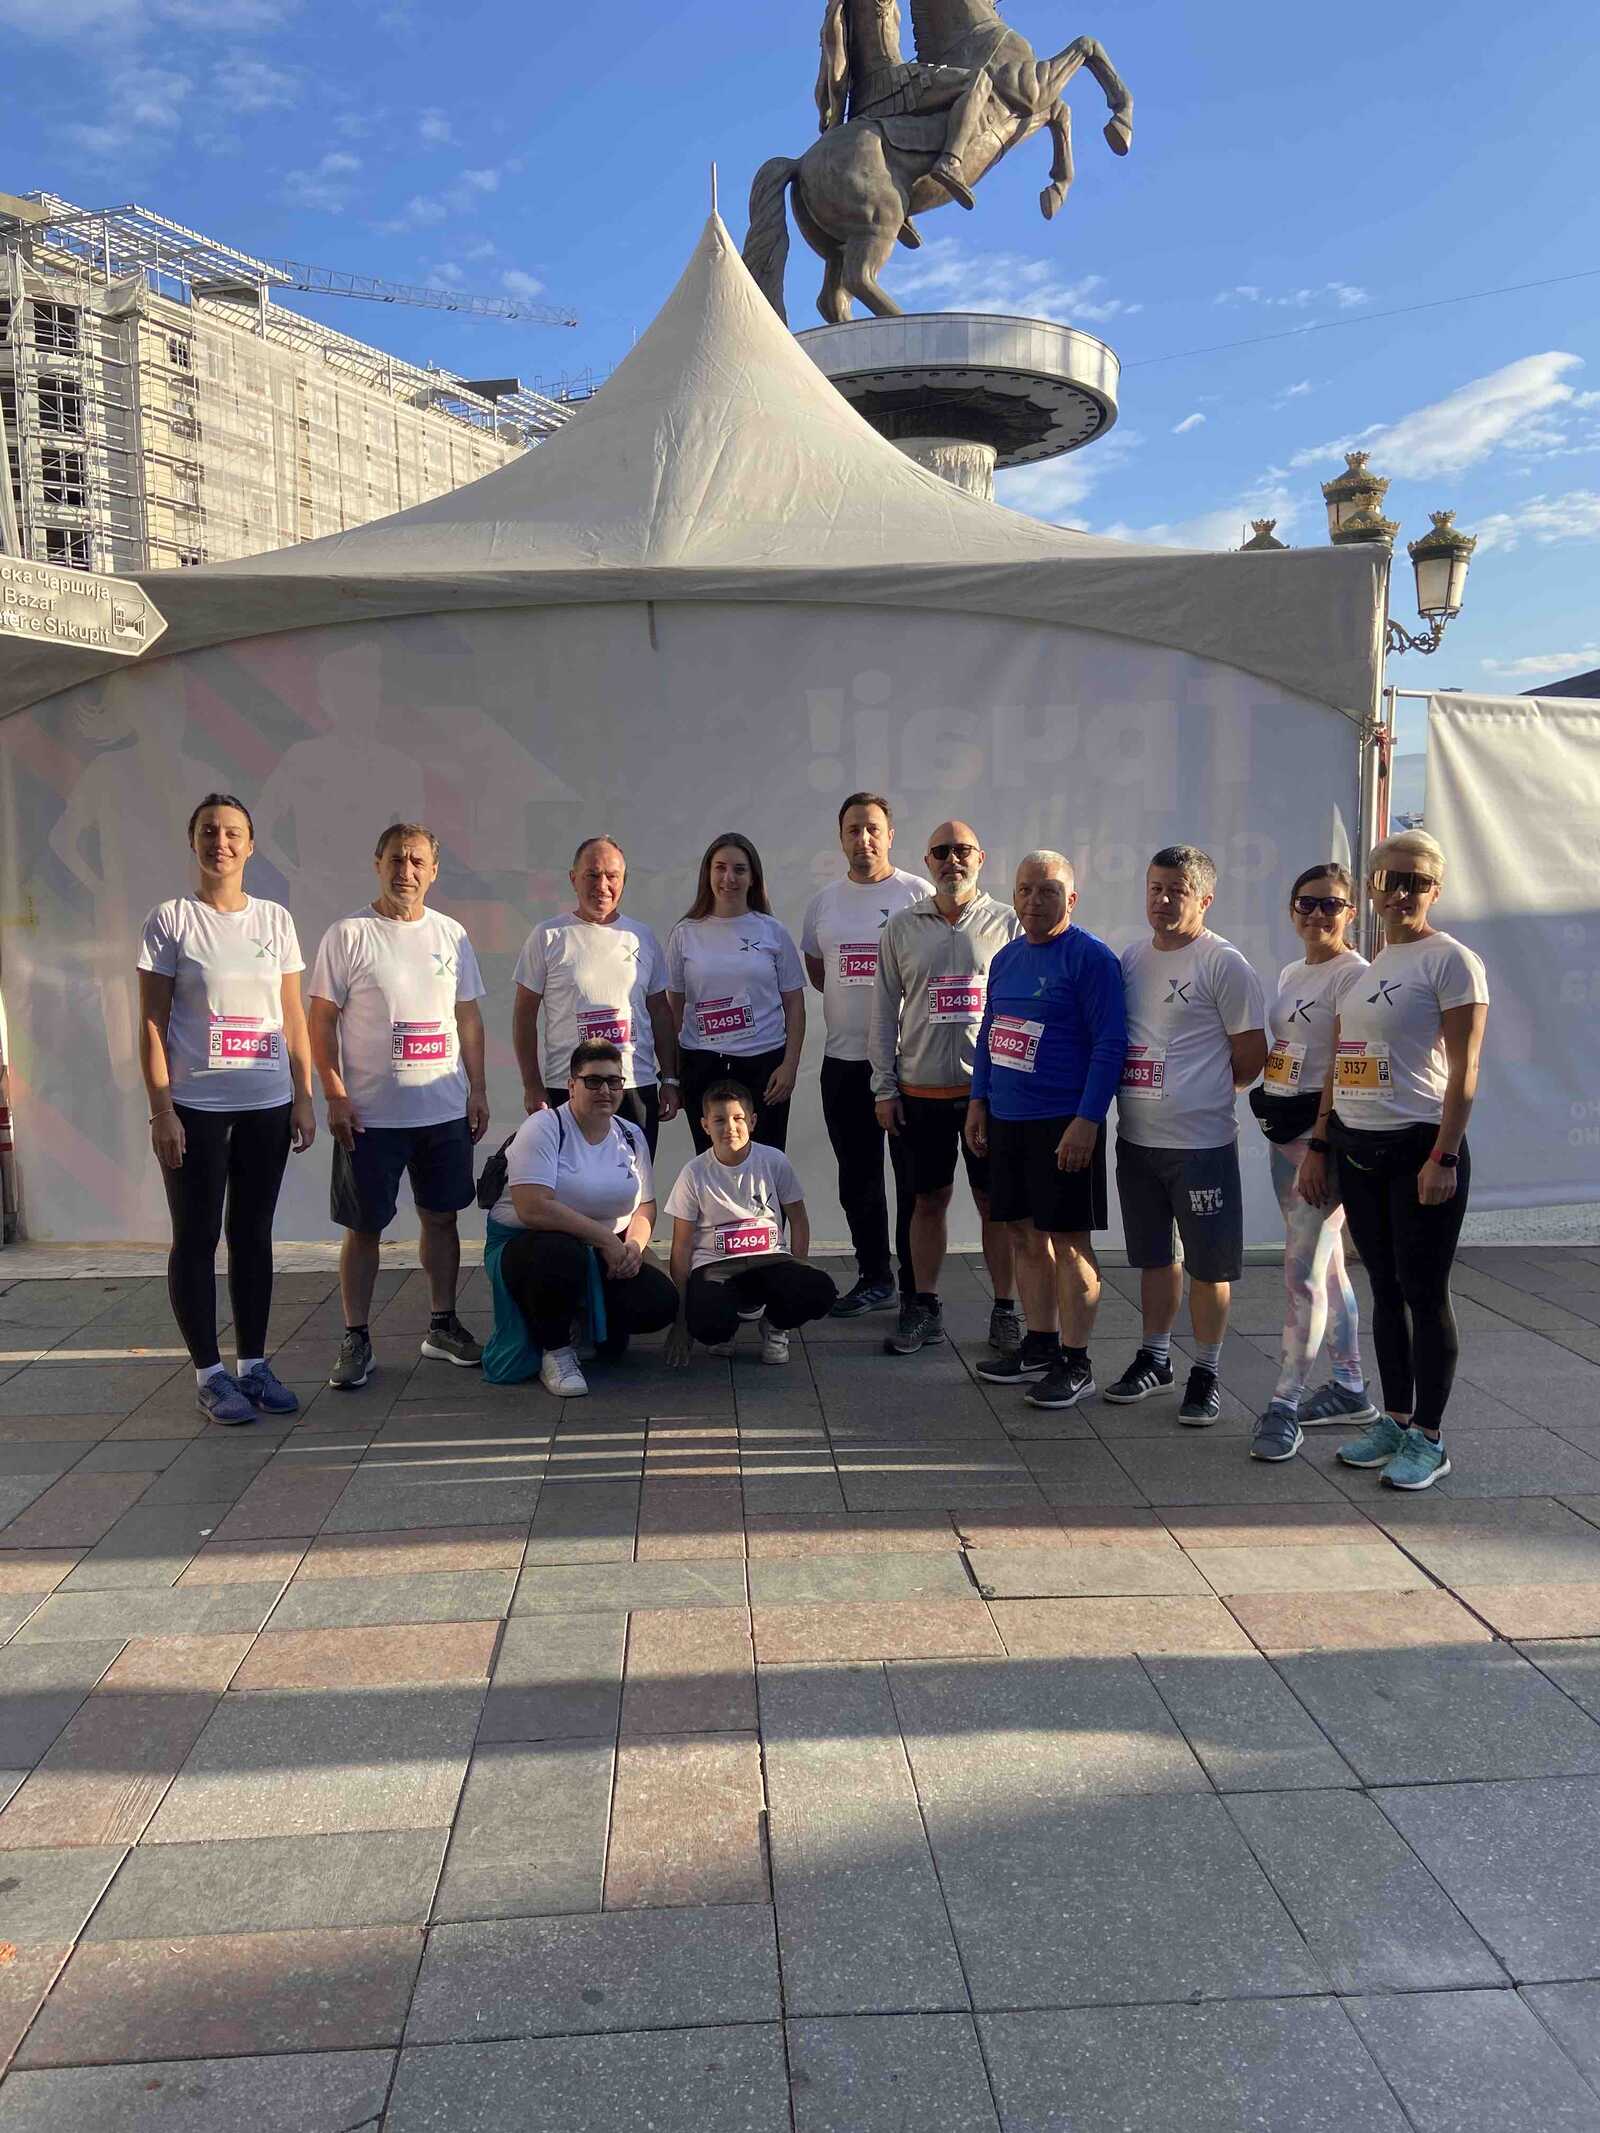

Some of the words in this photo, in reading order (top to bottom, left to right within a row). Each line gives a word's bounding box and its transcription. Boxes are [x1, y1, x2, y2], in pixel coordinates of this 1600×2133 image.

[37, 569, 110, 602] Чаршија
[4, 586, 57, 611] Bazar
[30, 617, 41, 631] e
[44, 616, 111, 644] Shkupit
[940, 994, 978, 1007] 12498
[706, 1014, 742, 1030] 12495
[591, 1026, 626, 1039] 12497
[225, 1038, 268, 1053] 12496
[408, 1041, 443, 1055] 12491
[993, 1034, 1024, 1052] 12492
[1343, 1061, 1368, 1075] 3137
[1188, 1187, 1223, 1212] NYC
[727, 1235, 767, 1249] 12494
